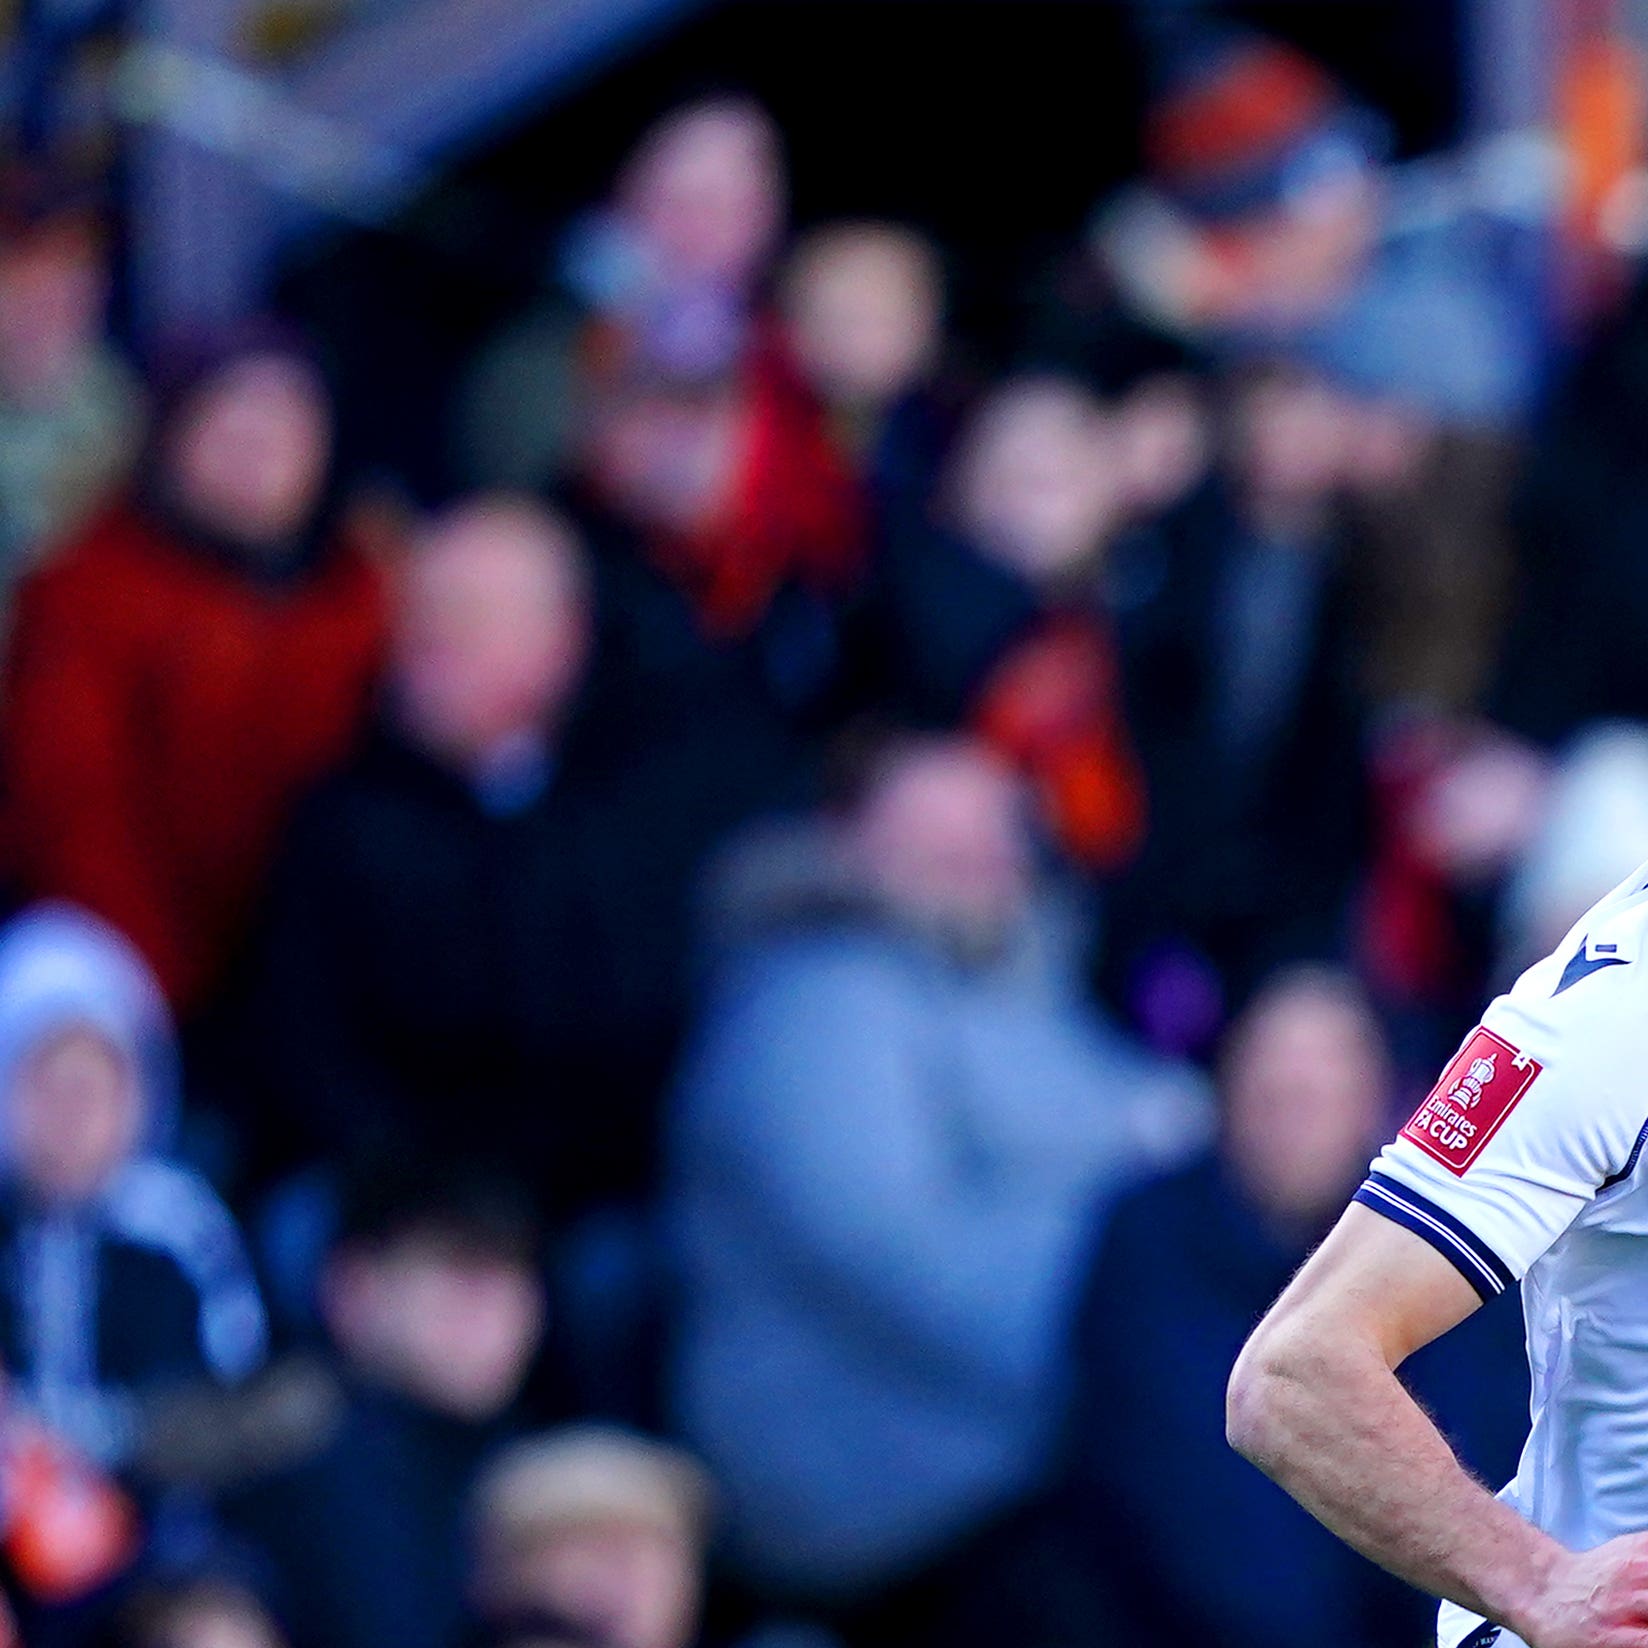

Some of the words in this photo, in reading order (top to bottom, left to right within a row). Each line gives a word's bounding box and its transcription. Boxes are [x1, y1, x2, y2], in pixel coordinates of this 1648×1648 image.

[1414, 1108, 1434, 1131] FA
[1429, 1119, 1468, 1150] CUP
[1426, 1095, 1477, 1138] Emirates
